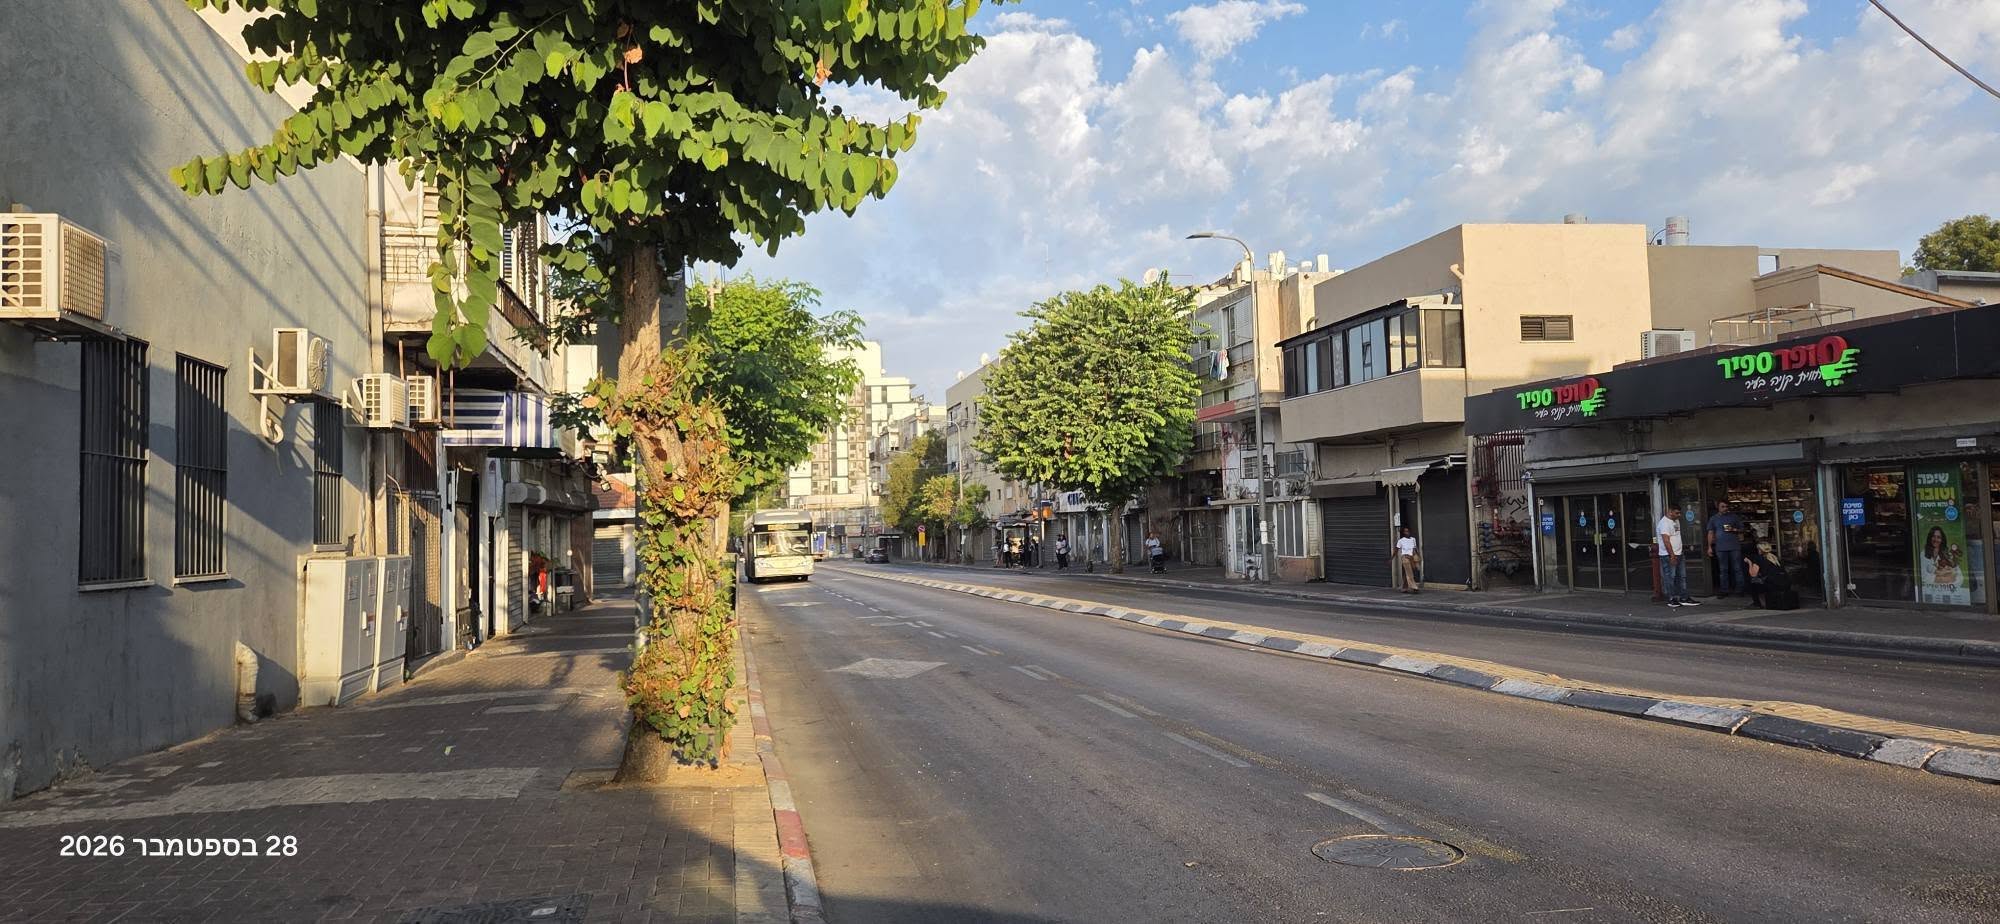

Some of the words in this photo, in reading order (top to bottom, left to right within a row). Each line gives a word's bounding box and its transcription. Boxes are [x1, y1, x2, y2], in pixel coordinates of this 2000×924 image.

[1718, 351, 1773, 378] ספיר
[1744, 377, 1767, 390] בעיר
[1769, 374, 1794, 392] קניה
[1516, 388, 1552, 409] ספיר
[1535, 408, 1549, 418] בעיר
[1550, 406, 1566, 421] קניה
